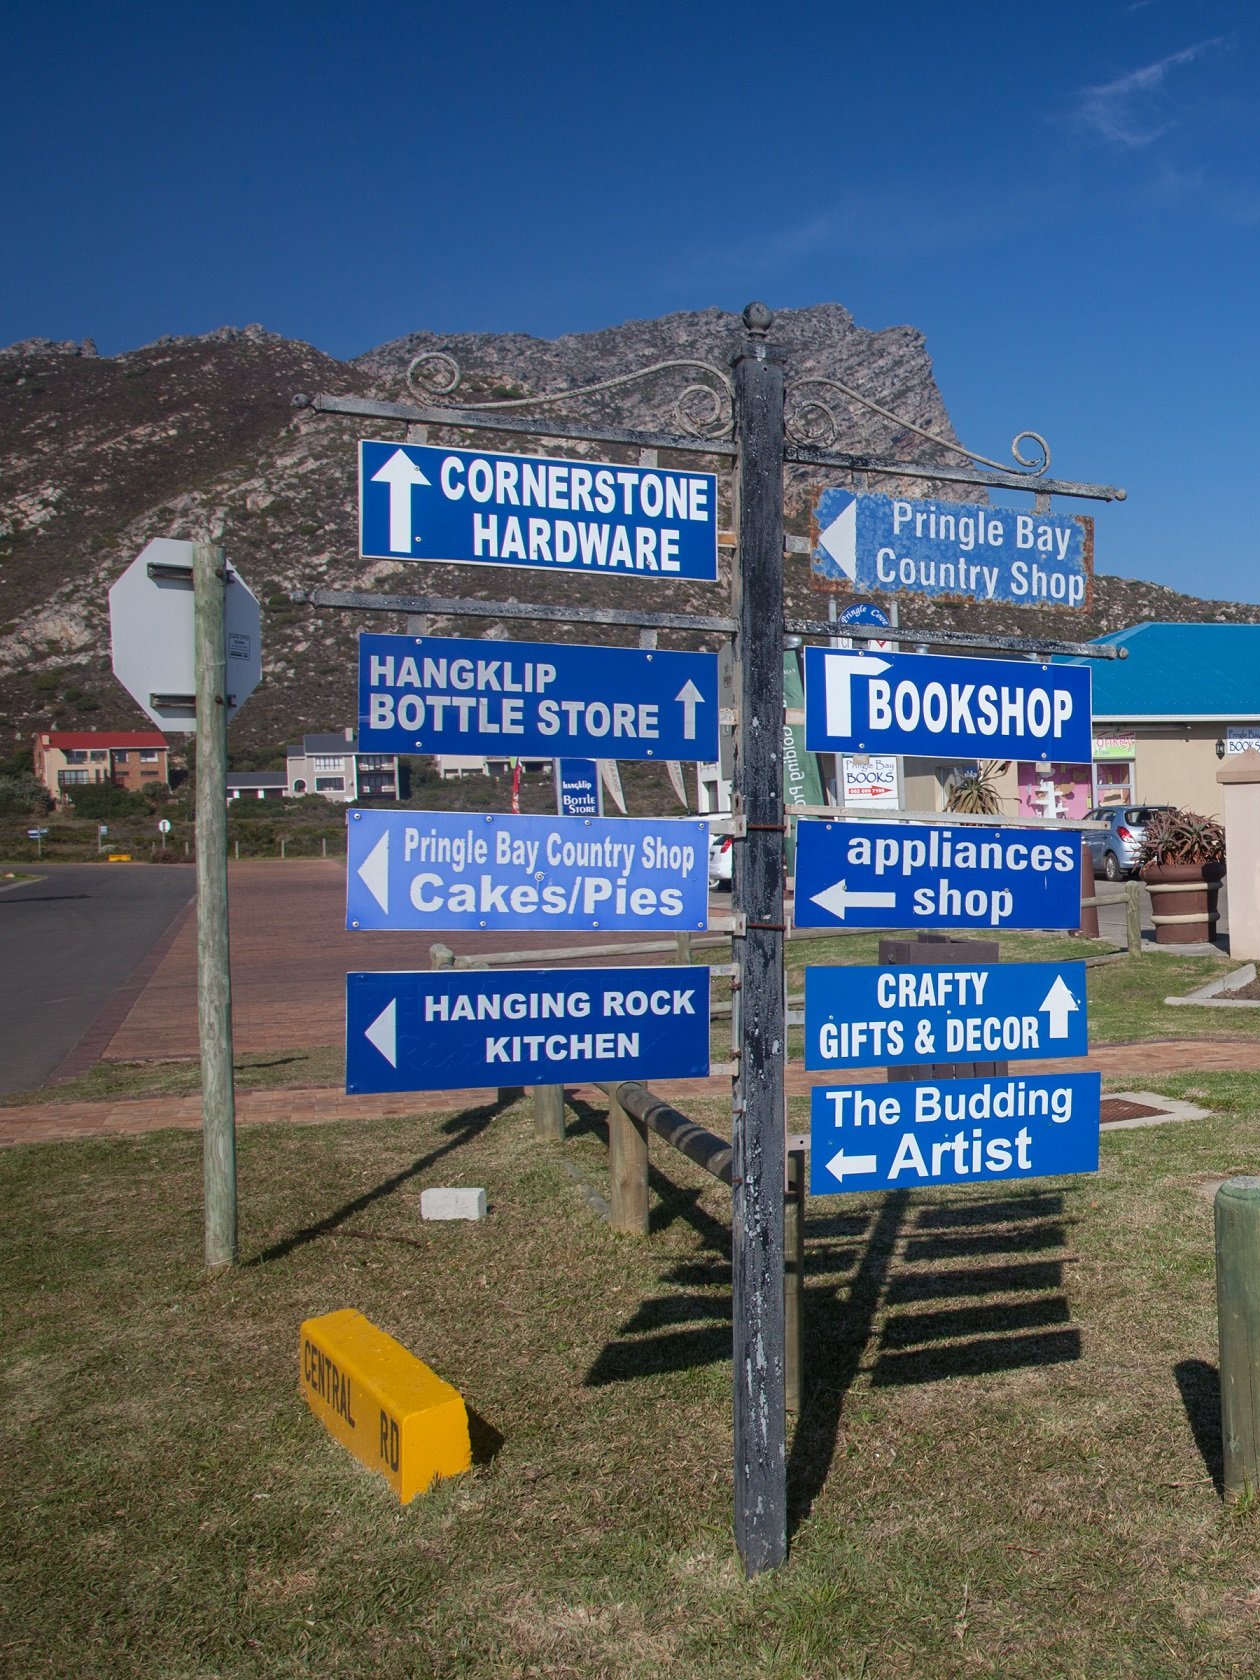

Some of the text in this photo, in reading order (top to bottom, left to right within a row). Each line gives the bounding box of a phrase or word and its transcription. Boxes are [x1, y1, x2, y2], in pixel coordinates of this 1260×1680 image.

[440, 456, 708, 522] CORNERSTONE
[473, 512, 681, 571] HARDWARE
[893, 501, 1071, 560] Pringle Bay
[876, 547, 1084, 606] Country Shop
[870, 609, 889, 625] Cove
[370, 655, 557, 694] HANGKLIP
[370, 693, 659, 739] BOTTLE STORE
[868, 678, 1073, 738] BOOKSHOP
[847, 772, 895, 784] BOOKS
[875, 760, 895, 771] Bay
[403, 827, 695, 878] Pringle Bay Country Shop
[847, 831, 1075, 876] appliances
[409, 872, 684, 917] Cakes/Pies
[913, 879, 1014, 925] shop
[424, 991, 590, 1022] HANGING
[603, 989, 696, 1016] ROCK
[877, 972, 989, 1009] CRAFTY
[486, 1032, 640, 1063] KITCHEN
[819, 1016, 1040, 1059] GIFTS & DECOR
[825, 1082, 1073, 1128] The Budding
[887, 1126, 1033, 1181] Artist
[304, 1339, 400, 1473] CENTRAL RD
